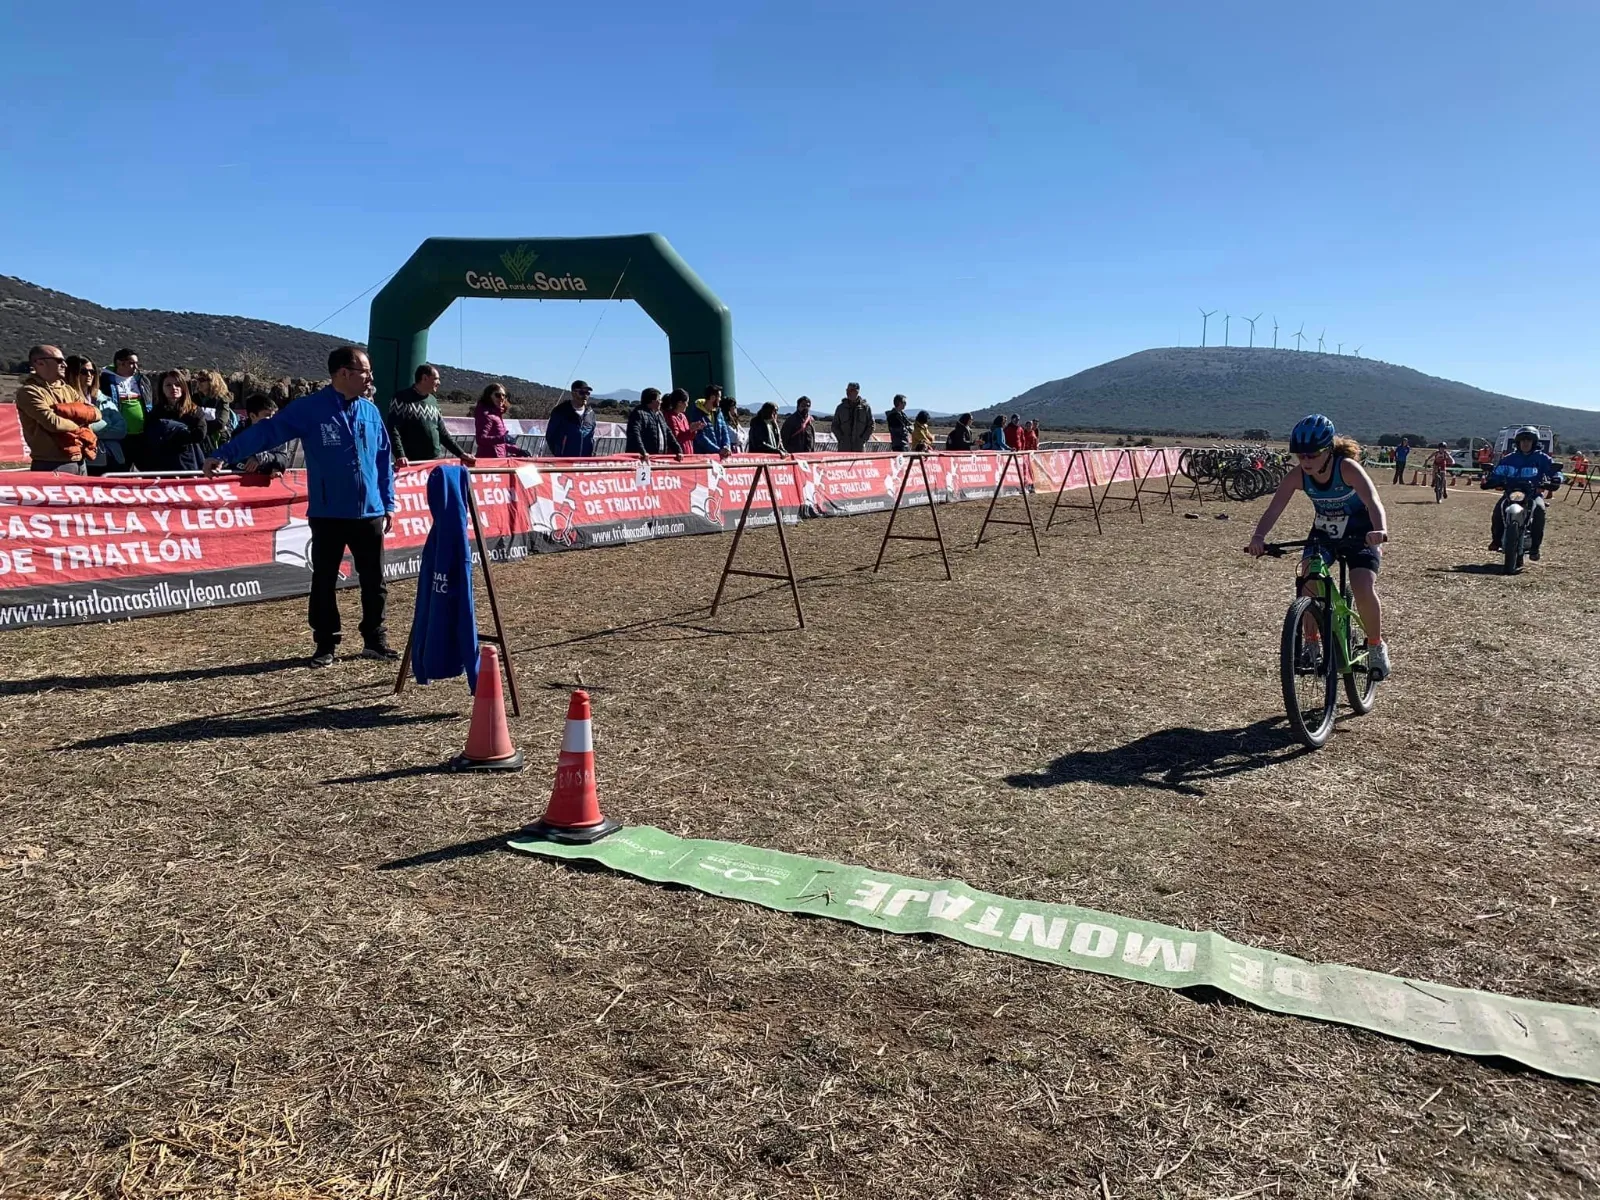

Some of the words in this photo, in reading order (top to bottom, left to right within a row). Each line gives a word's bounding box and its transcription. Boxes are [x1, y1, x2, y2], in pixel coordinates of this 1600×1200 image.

[465, 270, 508, 292] Caja
[534, 271, 587, 291] Soria
[579, 477, 638, 496] CASTILLA
[651, 470, 682, 491] LEÓN
[640, 472, 646, 481] 2
[199, 484, 238, 501] DE
[584, 500, 605, 516] DE
[604, 492, 660, 512] TRIATLÓN
[729, 490, 742, 502] DE
[0, 512, 147, 540] ASTILLA
[150, 509, 171, 532] Y
[181, 502, 255, 532] LEÓN
[45, 531, 202, 571] TRIATLÓN
[845, 879, 1198, 972] MONTAJE
